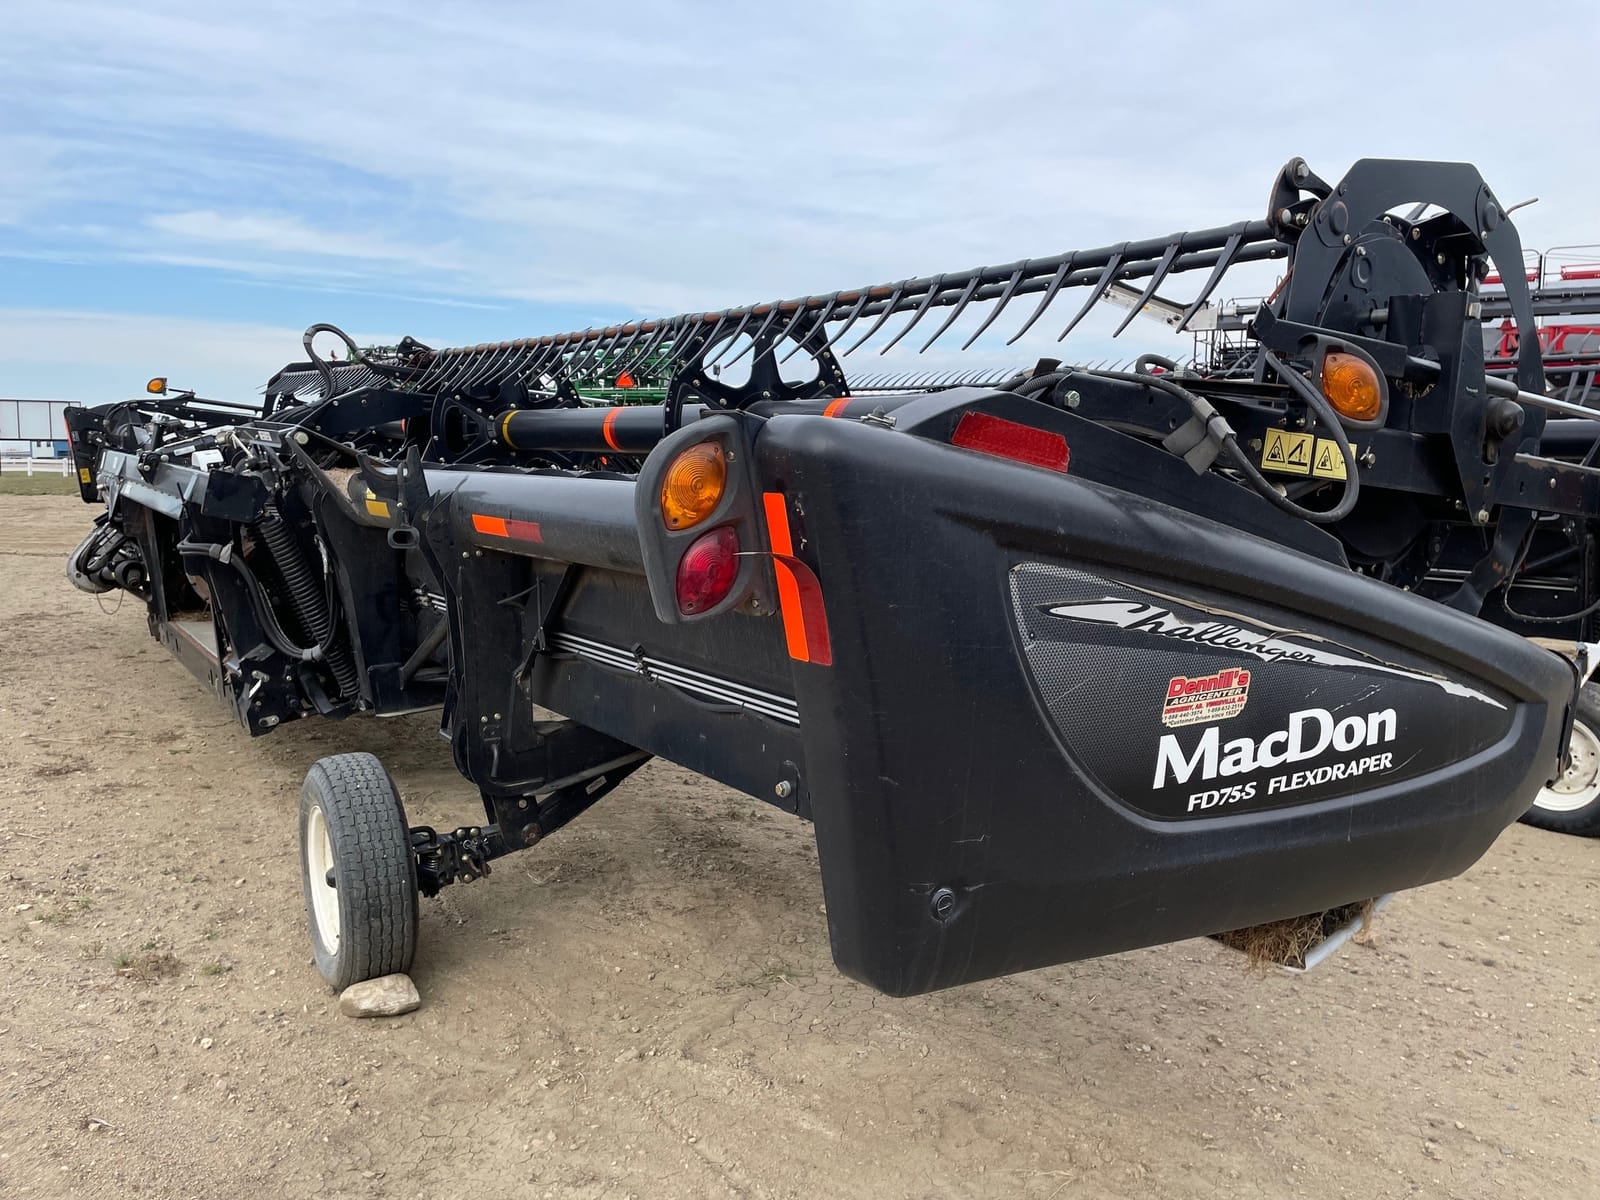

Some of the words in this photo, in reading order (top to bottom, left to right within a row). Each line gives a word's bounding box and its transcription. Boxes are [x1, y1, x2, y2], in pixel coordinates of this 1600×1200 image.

[1035, 599, 1316, 663] Challenger
[1168, 671, 1249, 698] Dennill's
[1170, 688, 1243, 706] AGRICENTER
[1152, 708, 1397, 790] MacDon
[1187, 781, 1257, 812] FD75-S
[1267, 752, 1393, 796] FLEXDRAPER
